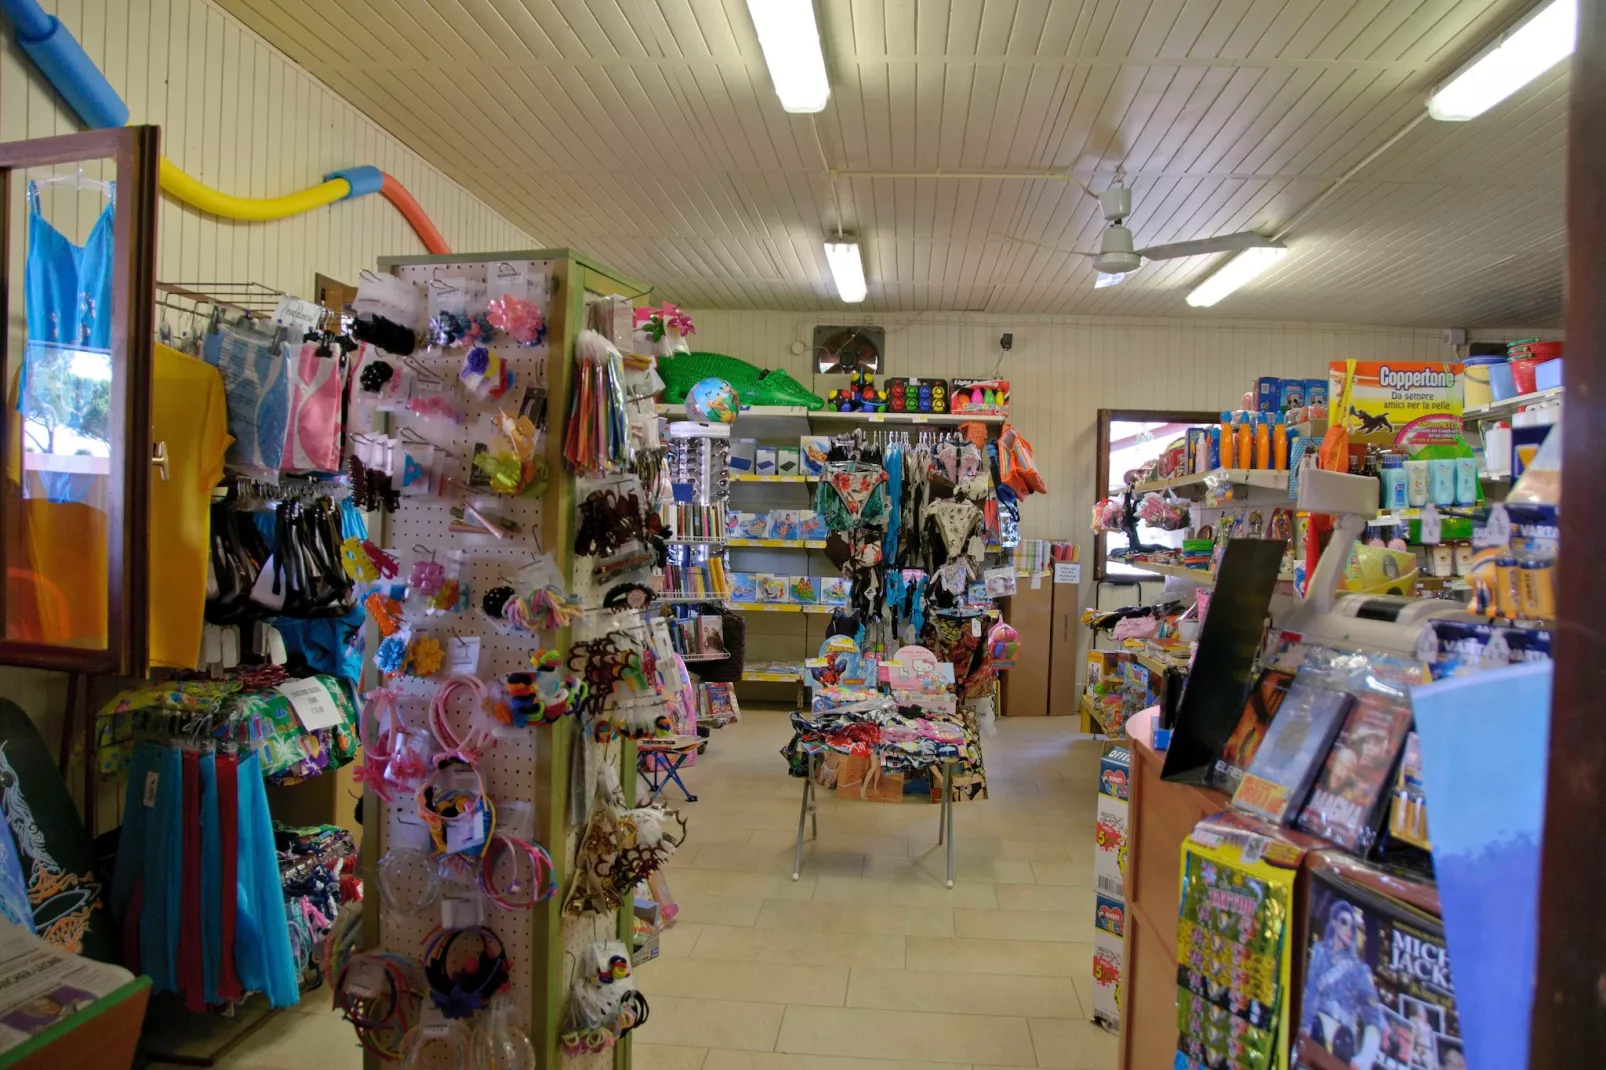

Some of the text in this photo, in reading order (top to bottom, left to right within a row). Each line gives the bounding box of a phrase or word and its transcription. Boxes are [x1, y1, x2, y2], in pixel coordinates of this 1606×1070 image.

[1380, 365, 1455, 390] Coppertone
[1391, 391, 1434, 401] Da sempre
[1384, 400, 1450, 410] amici per la pelle
[1520, 524, 1560, 539] VARTA
[1443, 638, 1488, 655] VART
[1108, 749, 1131, 762] OFFE
[1390, 948, 1455, 991] JACK
